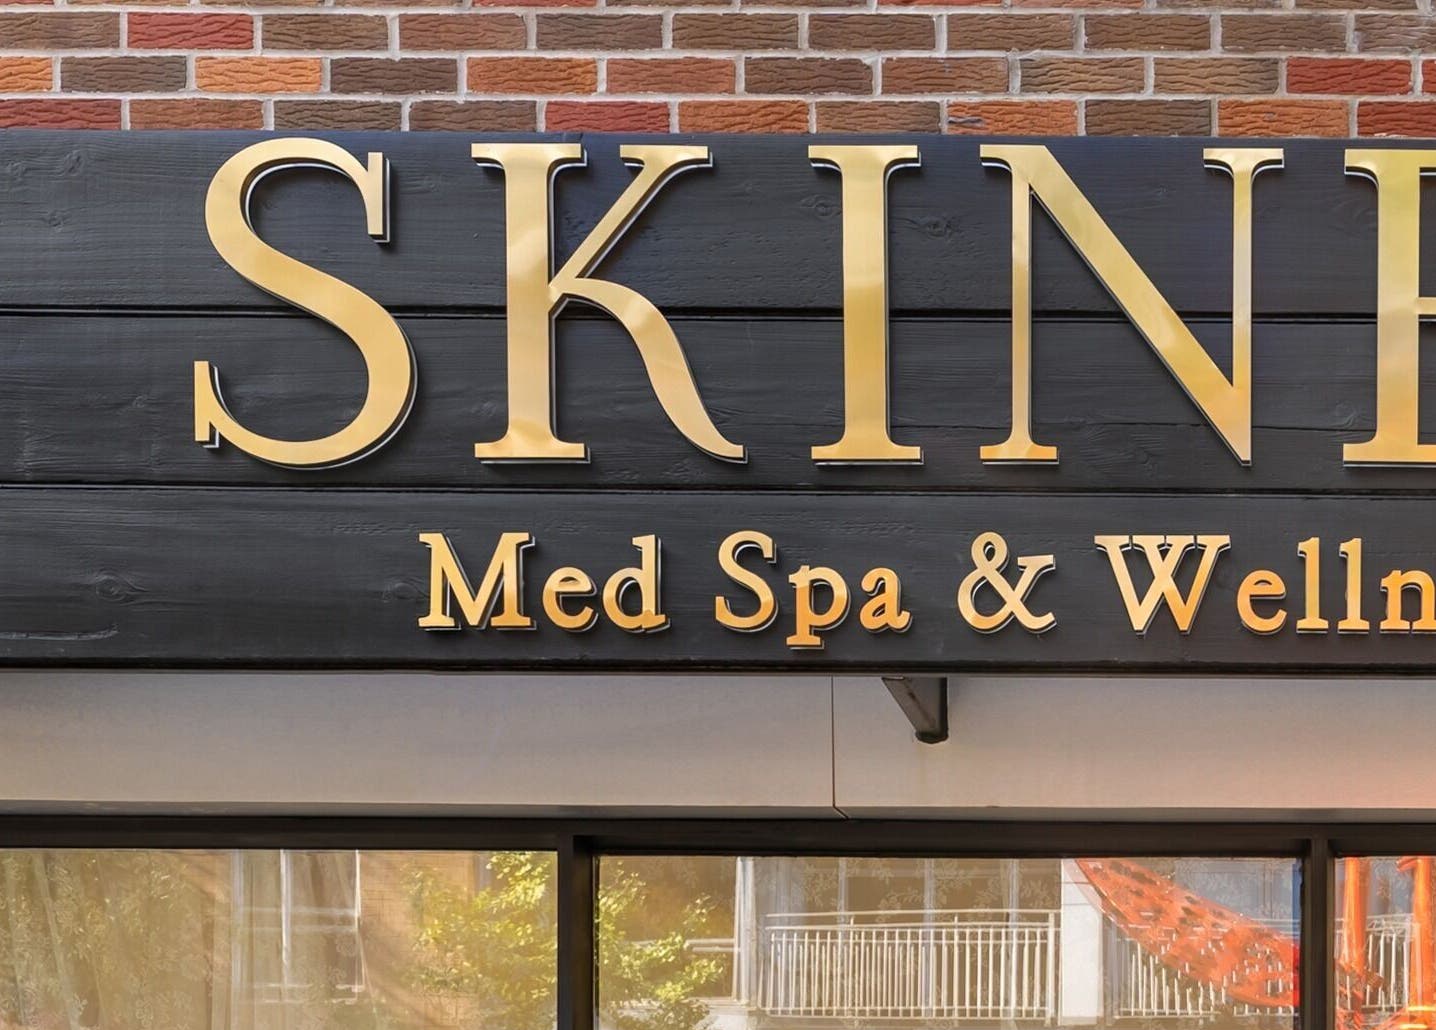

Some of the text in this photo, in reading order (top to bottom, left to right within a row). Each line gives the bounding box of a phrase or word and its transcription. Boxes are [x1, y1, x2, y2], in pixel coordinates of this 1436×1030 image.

[418, 531, 671, 632] Med
[715, 531, 913, 649] Spa
[957, 532, 1056, 634] &
